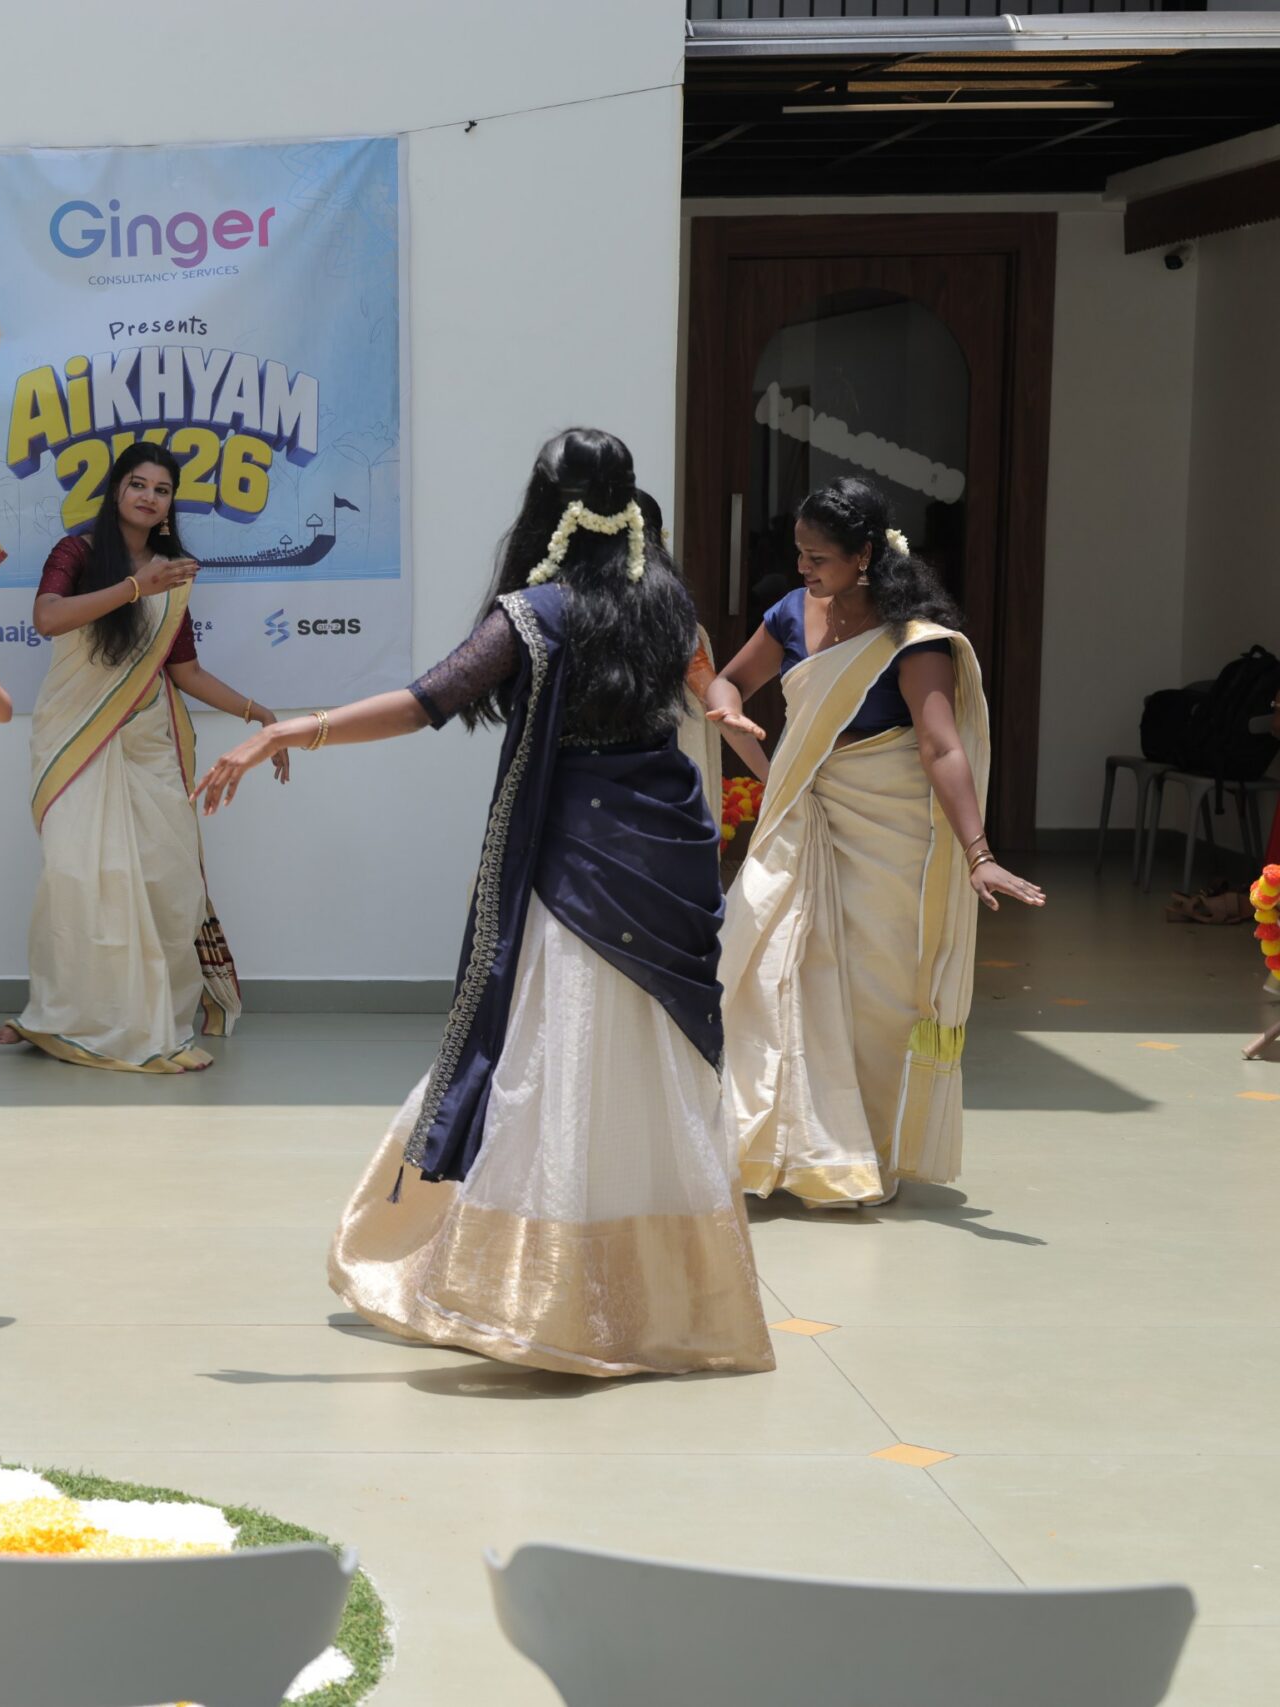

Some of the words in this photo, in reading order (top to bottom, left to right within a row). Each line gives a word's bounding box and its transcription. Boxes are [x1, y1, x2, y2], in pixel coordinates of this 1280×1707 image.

[50, 199, 276, 268] Ginger
[88, 272, 178, 286] CONSULTANCY
[182, 265, 240, 280] SERVICES
[109, 315, 208, 341] Presents
[7, 345, 319, 472] AiKHYAM
[55, 427, 273, 530] 226
